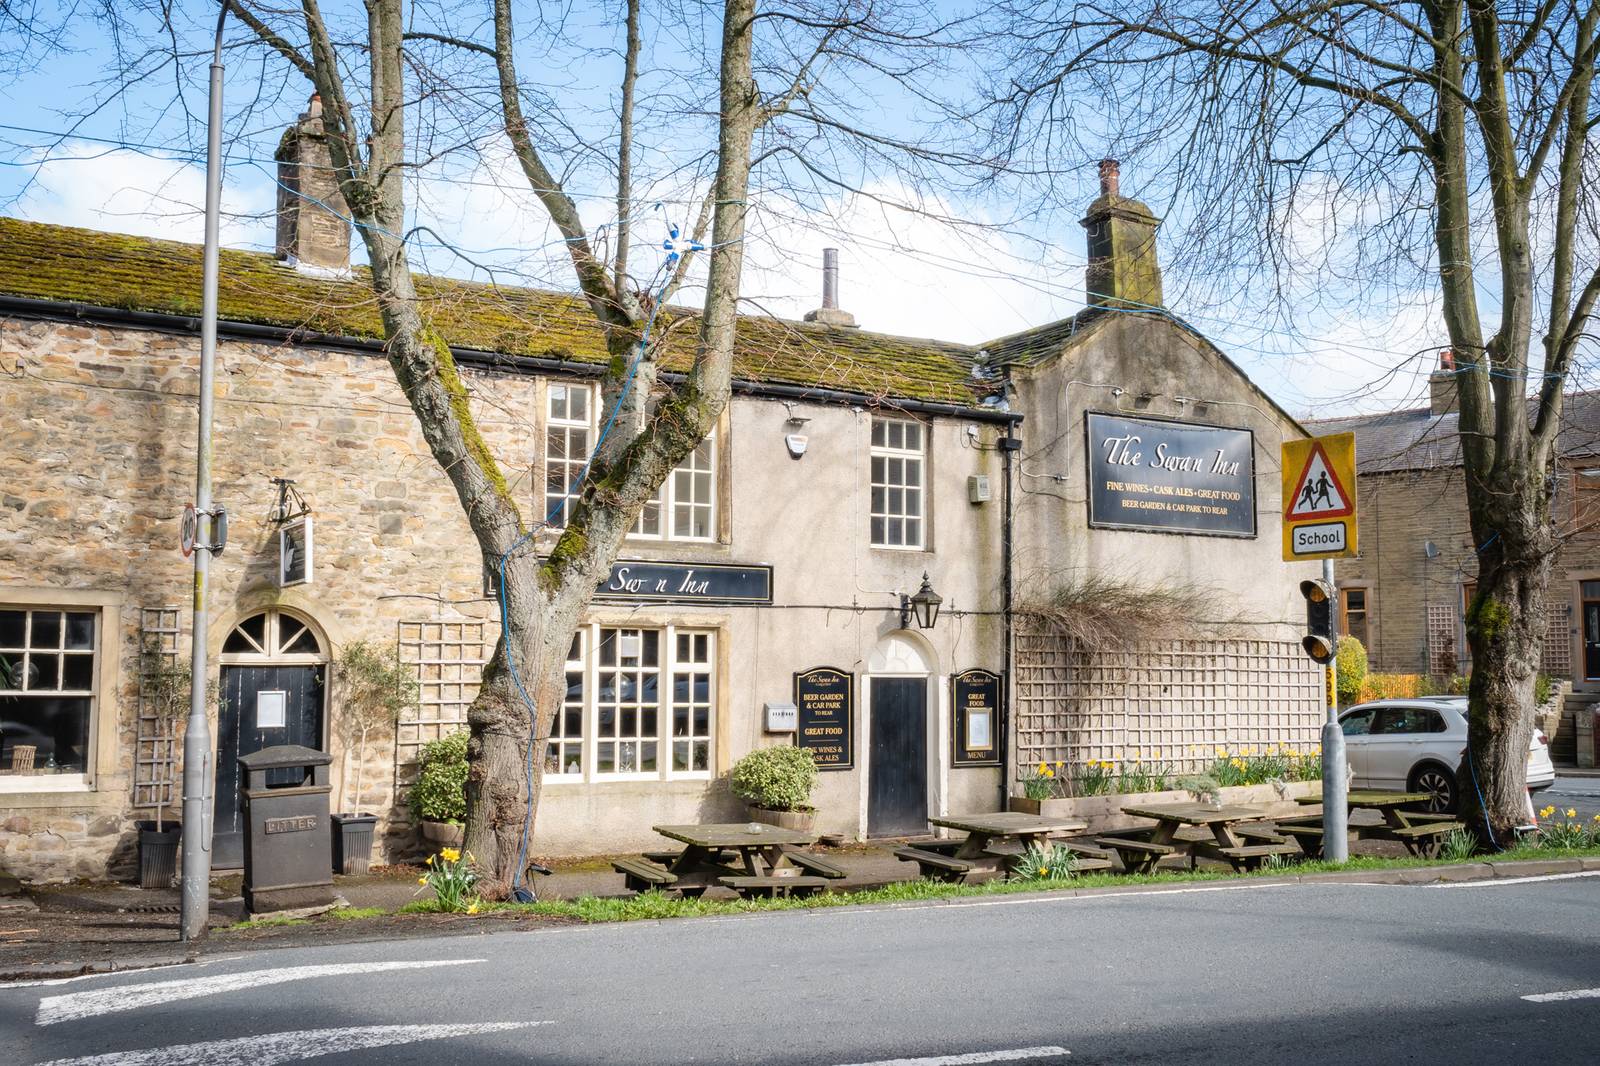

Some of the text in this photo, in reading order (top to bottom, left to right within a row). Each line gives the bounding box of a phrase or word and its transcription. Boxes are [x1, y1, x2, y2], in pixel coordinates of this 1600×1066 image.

[1103, 434, 1240, 476] The Swan Inn
[1106, 481, 1241, 501] FINE WINES CASK ALES GREAT FOOD
[1122, 499, 1139, 508] BEER
[1139, 501, 1165, 511] GARDEN
[1172, 503, 1186, 512] CAR
[1186, 505, 1201, 513] PARK
[1203, 506, 1212, 514] TO
[1212, 506, 1228, 515] REAR
[1298, 530, 1341, 546] School
[678, 570, 710, 594] Inn
[803, 693, 844, 701] BEER GARDEN
[804, 727, 843, 736] GREAT FOOD
[268, 819, 314, 832] LITTER
